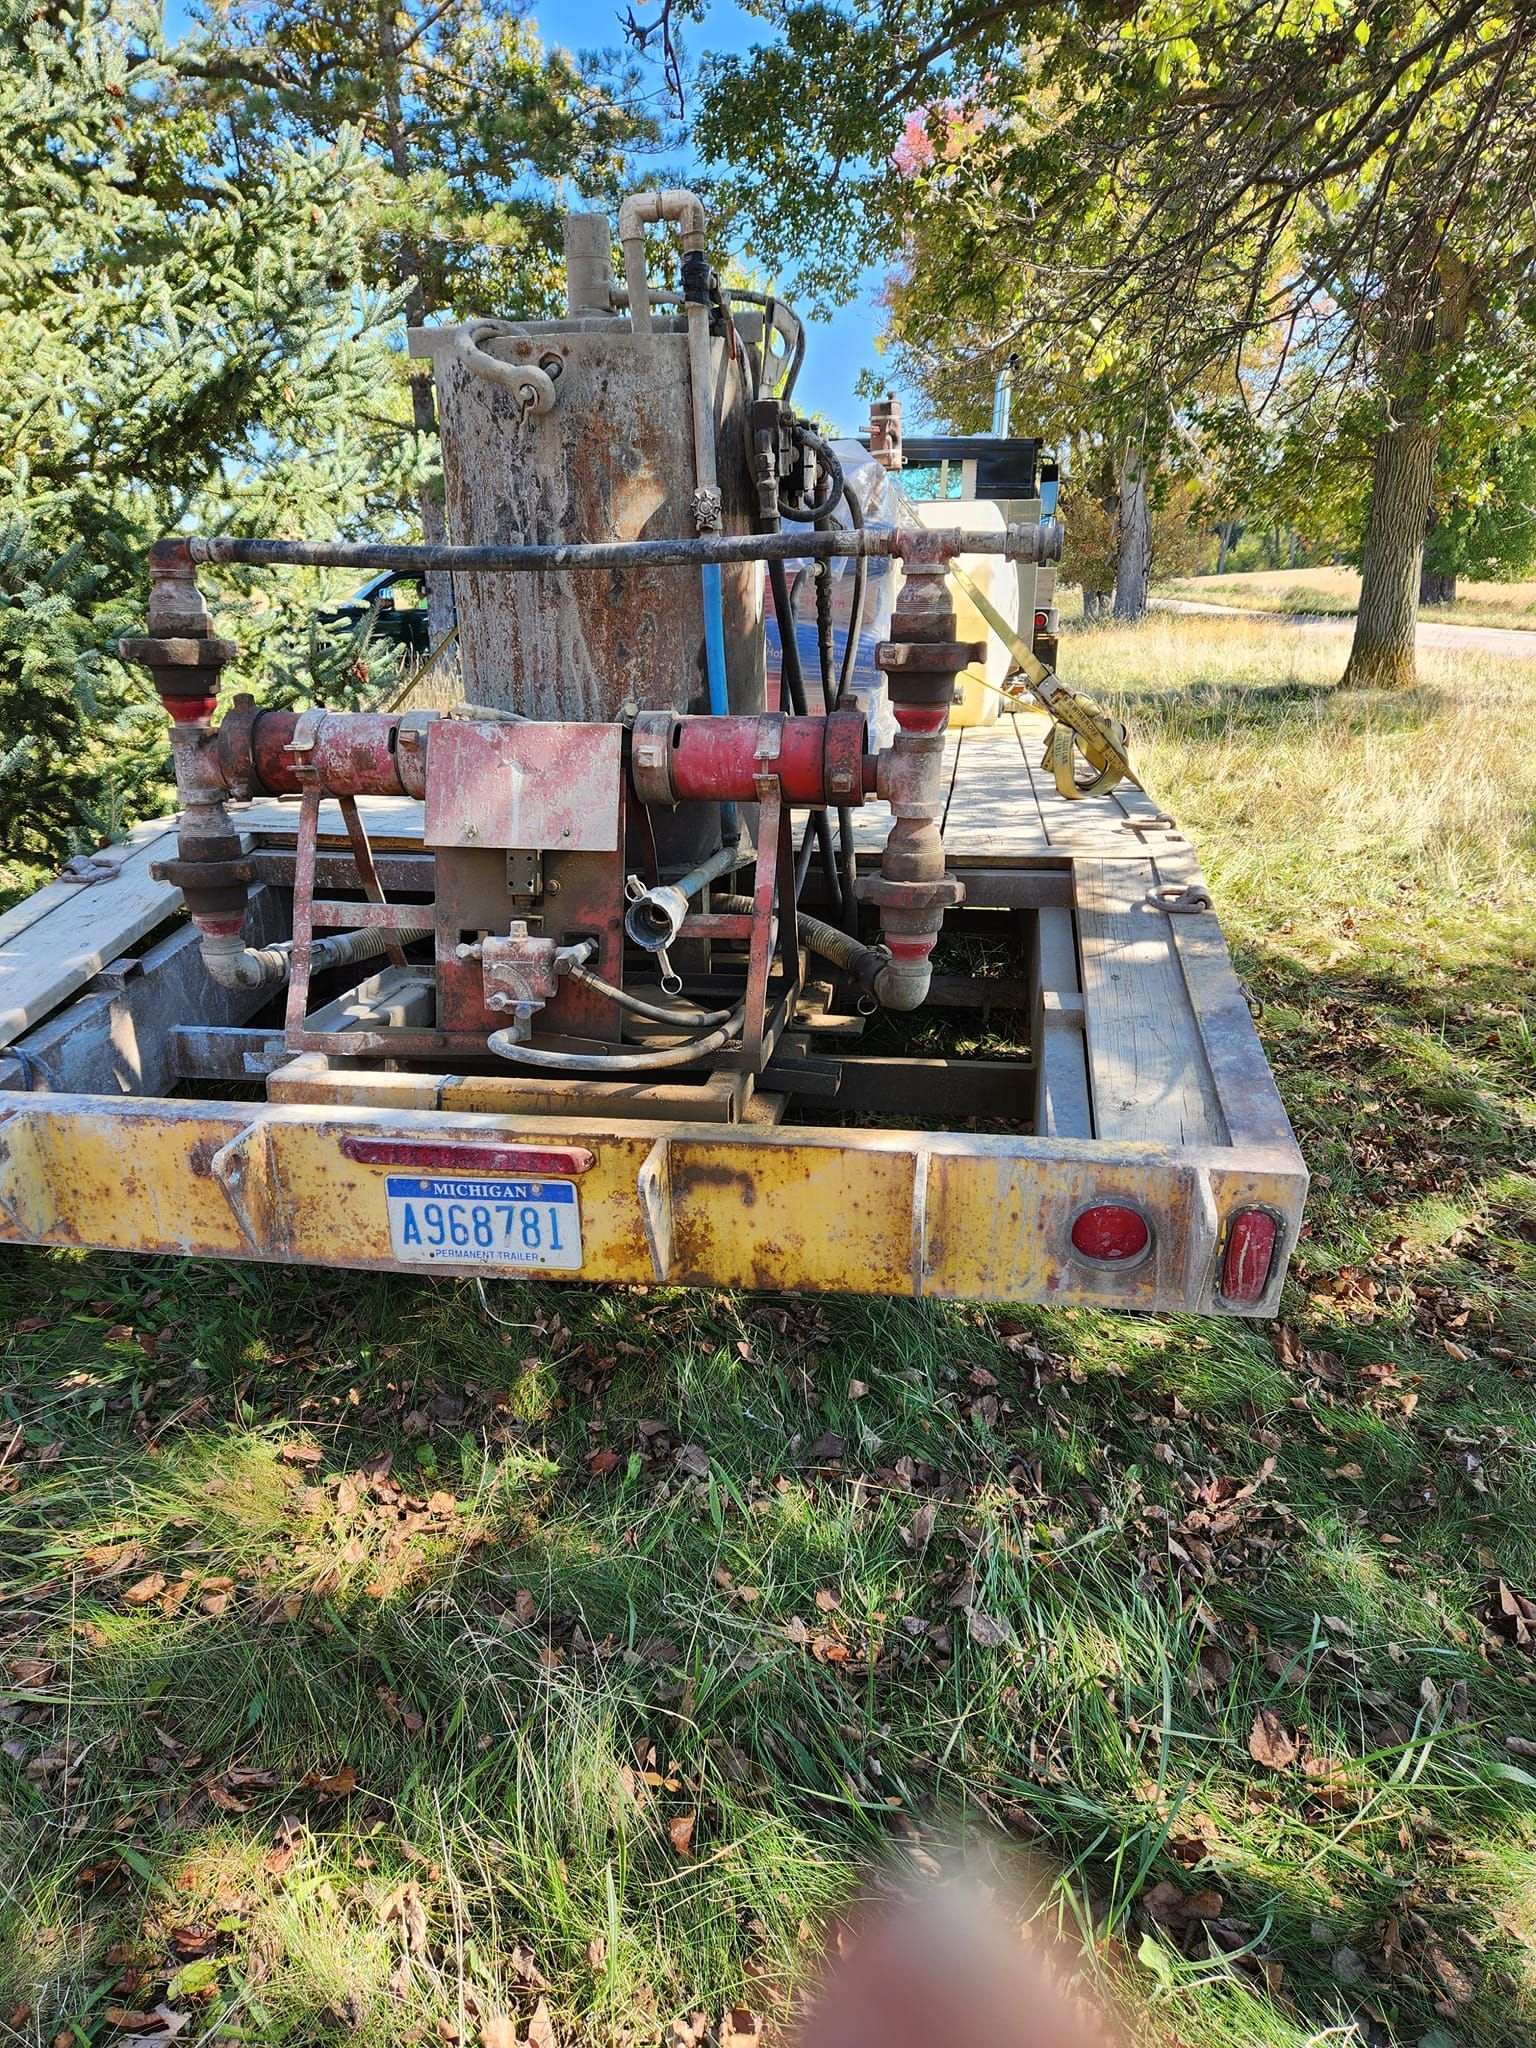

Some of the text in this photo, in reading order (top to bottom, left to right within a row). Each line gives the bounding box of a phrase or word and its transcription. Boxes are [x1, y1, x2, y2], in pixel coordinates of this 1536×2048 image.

[434, 1183, 527, 1198] MICHIGAN
[403, 1202, 564, 1250] A968781
[435, 1249, 539, 1261] PERMANENT TRAILER
